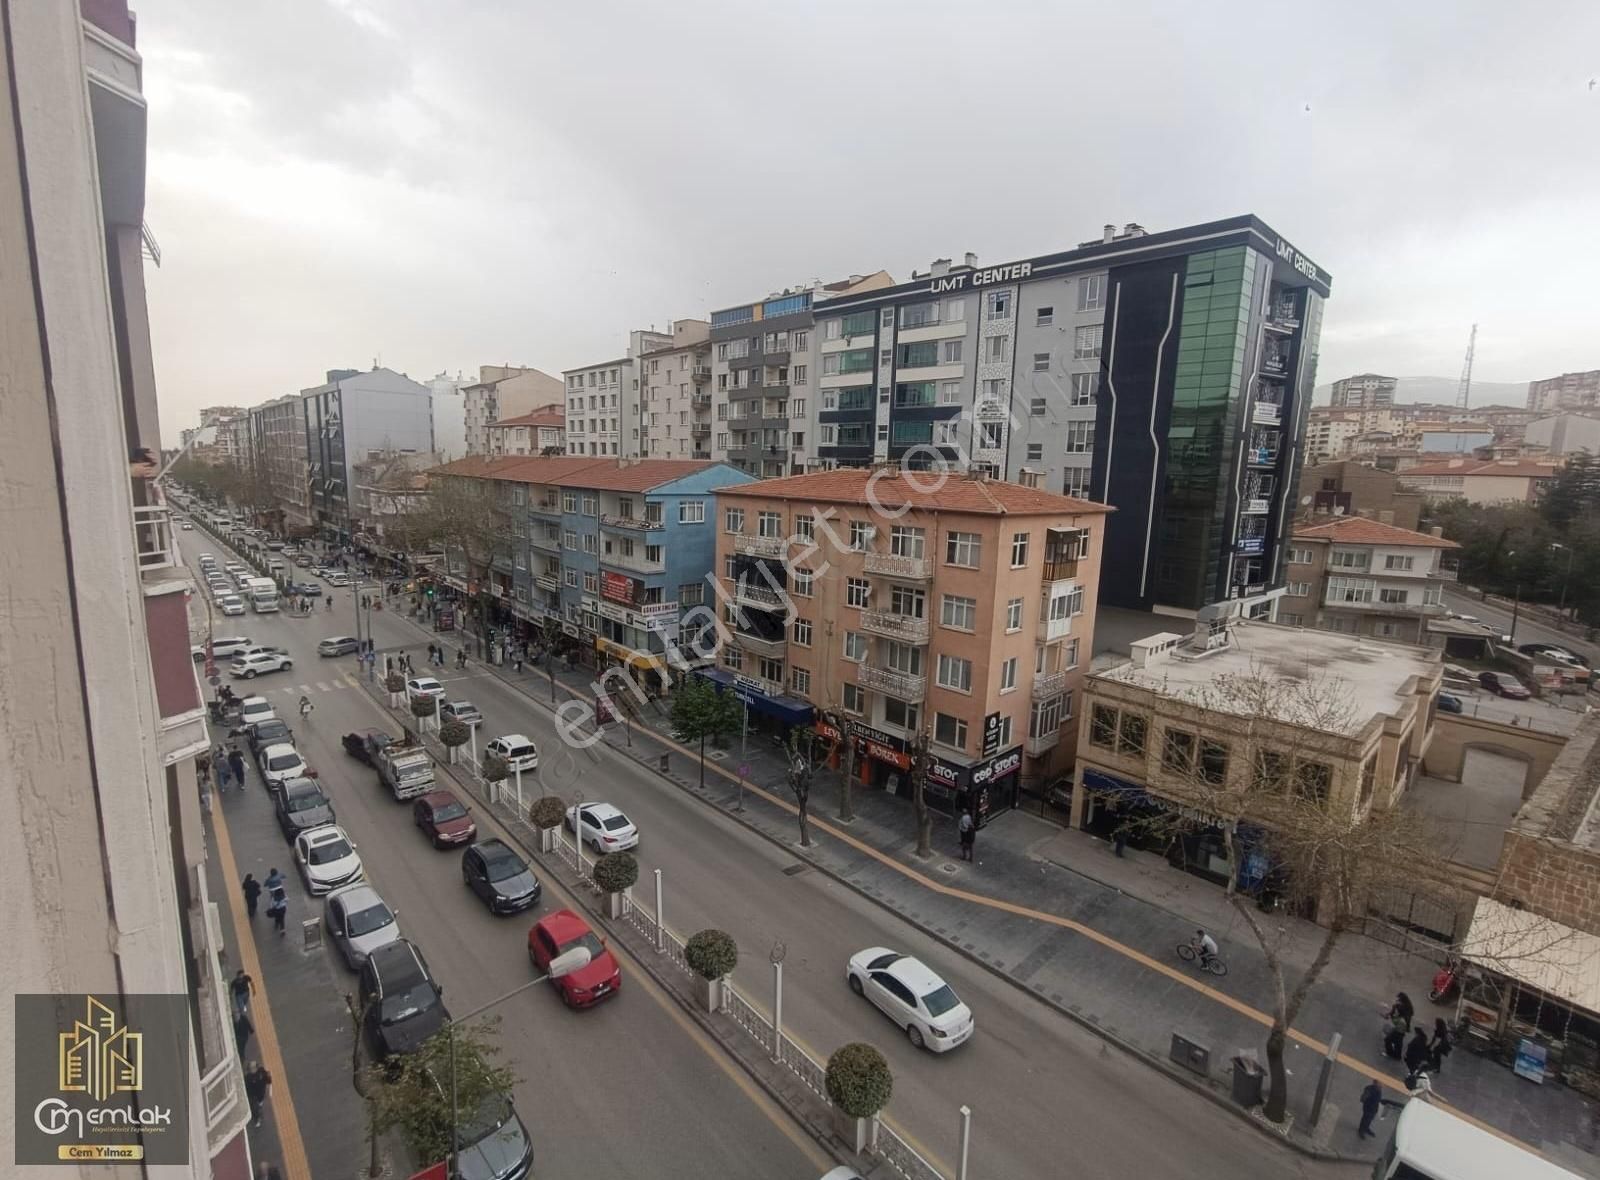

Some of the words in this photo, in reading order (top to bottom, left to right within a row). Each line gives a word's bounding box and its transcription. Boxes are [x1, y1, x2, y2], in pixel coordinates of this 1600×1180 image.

[930, 275, 967, 294] UMT
[972, 262, 1033, 286] CENTER
[1275, 237, 1294, 264] UMT
[1294, 250, 1317, 282] CENTER
